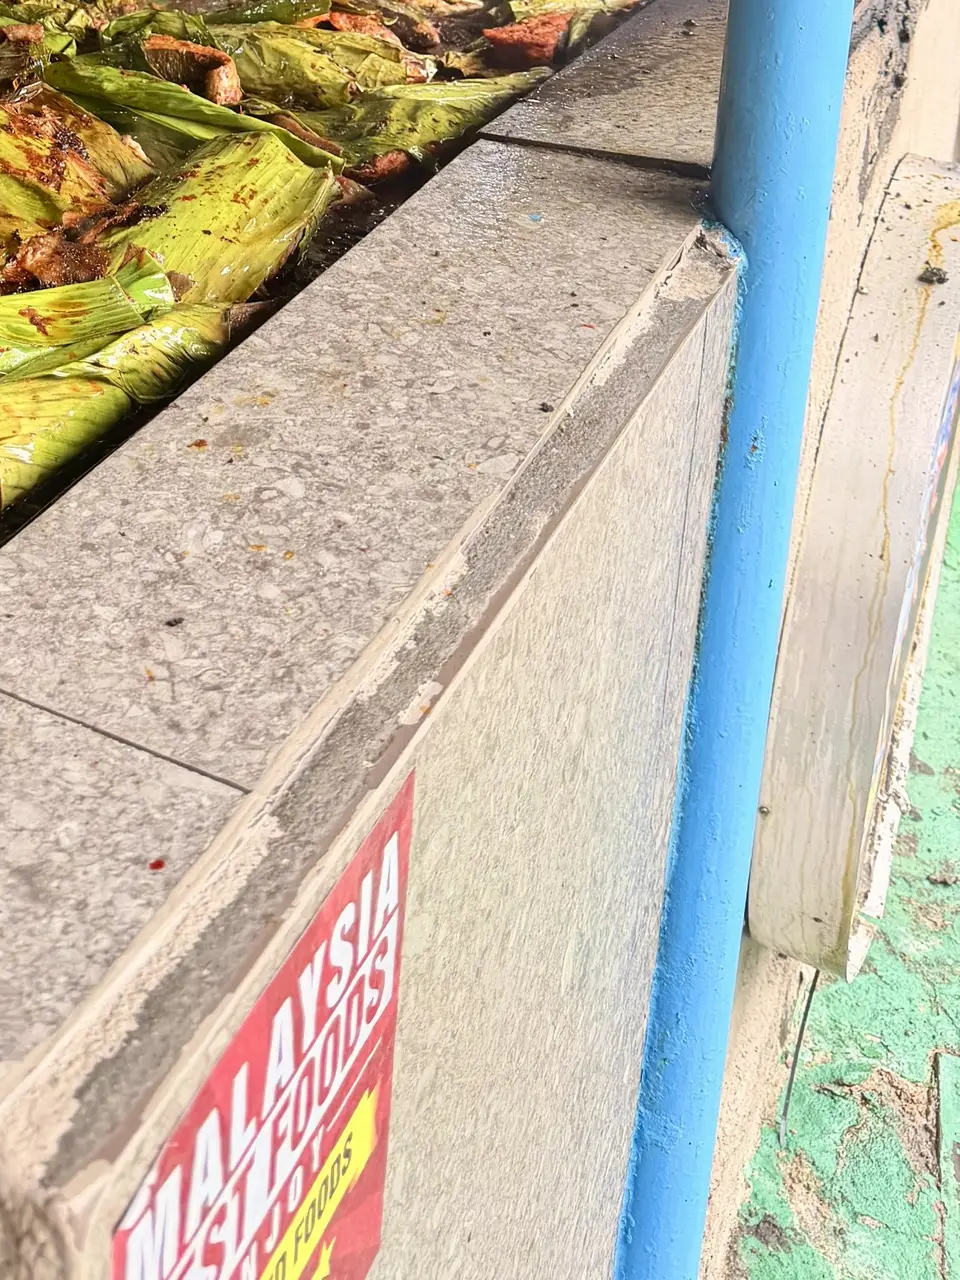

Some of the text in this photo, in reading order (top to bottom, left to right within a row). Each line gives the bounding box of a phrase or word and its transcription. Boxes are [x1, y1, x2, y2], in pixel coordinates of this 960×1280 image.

[125, 830, 399, 1280] MALAYSIA
[266, 933, 389, 1197] FOODS
[241, 1123, 324, 1280] NJOY
[292, 1130, 354, 1267] FOODS
